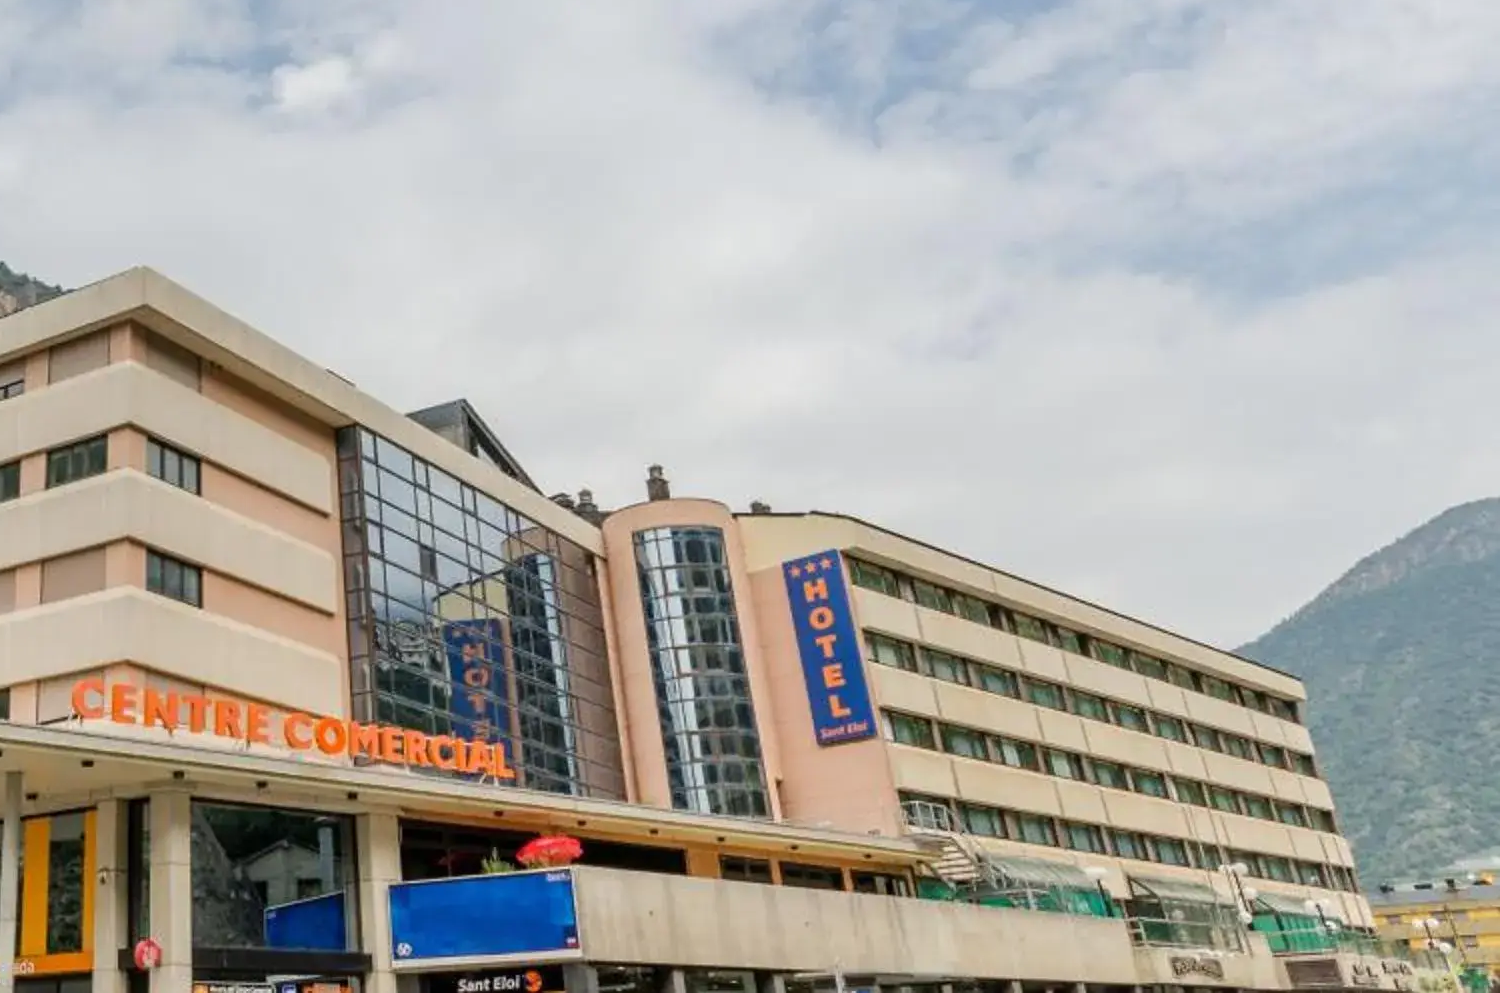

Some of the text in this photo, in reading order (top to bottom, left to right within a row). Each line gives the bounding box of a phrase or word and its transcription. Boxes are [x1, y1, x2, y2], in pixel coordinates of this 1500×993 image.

[803, 577, 852, 719] HOTEL
[71, 679, 517, 779] CENTRE COMERCIAL
[457, 974, 521, 993] Sant Eloi
